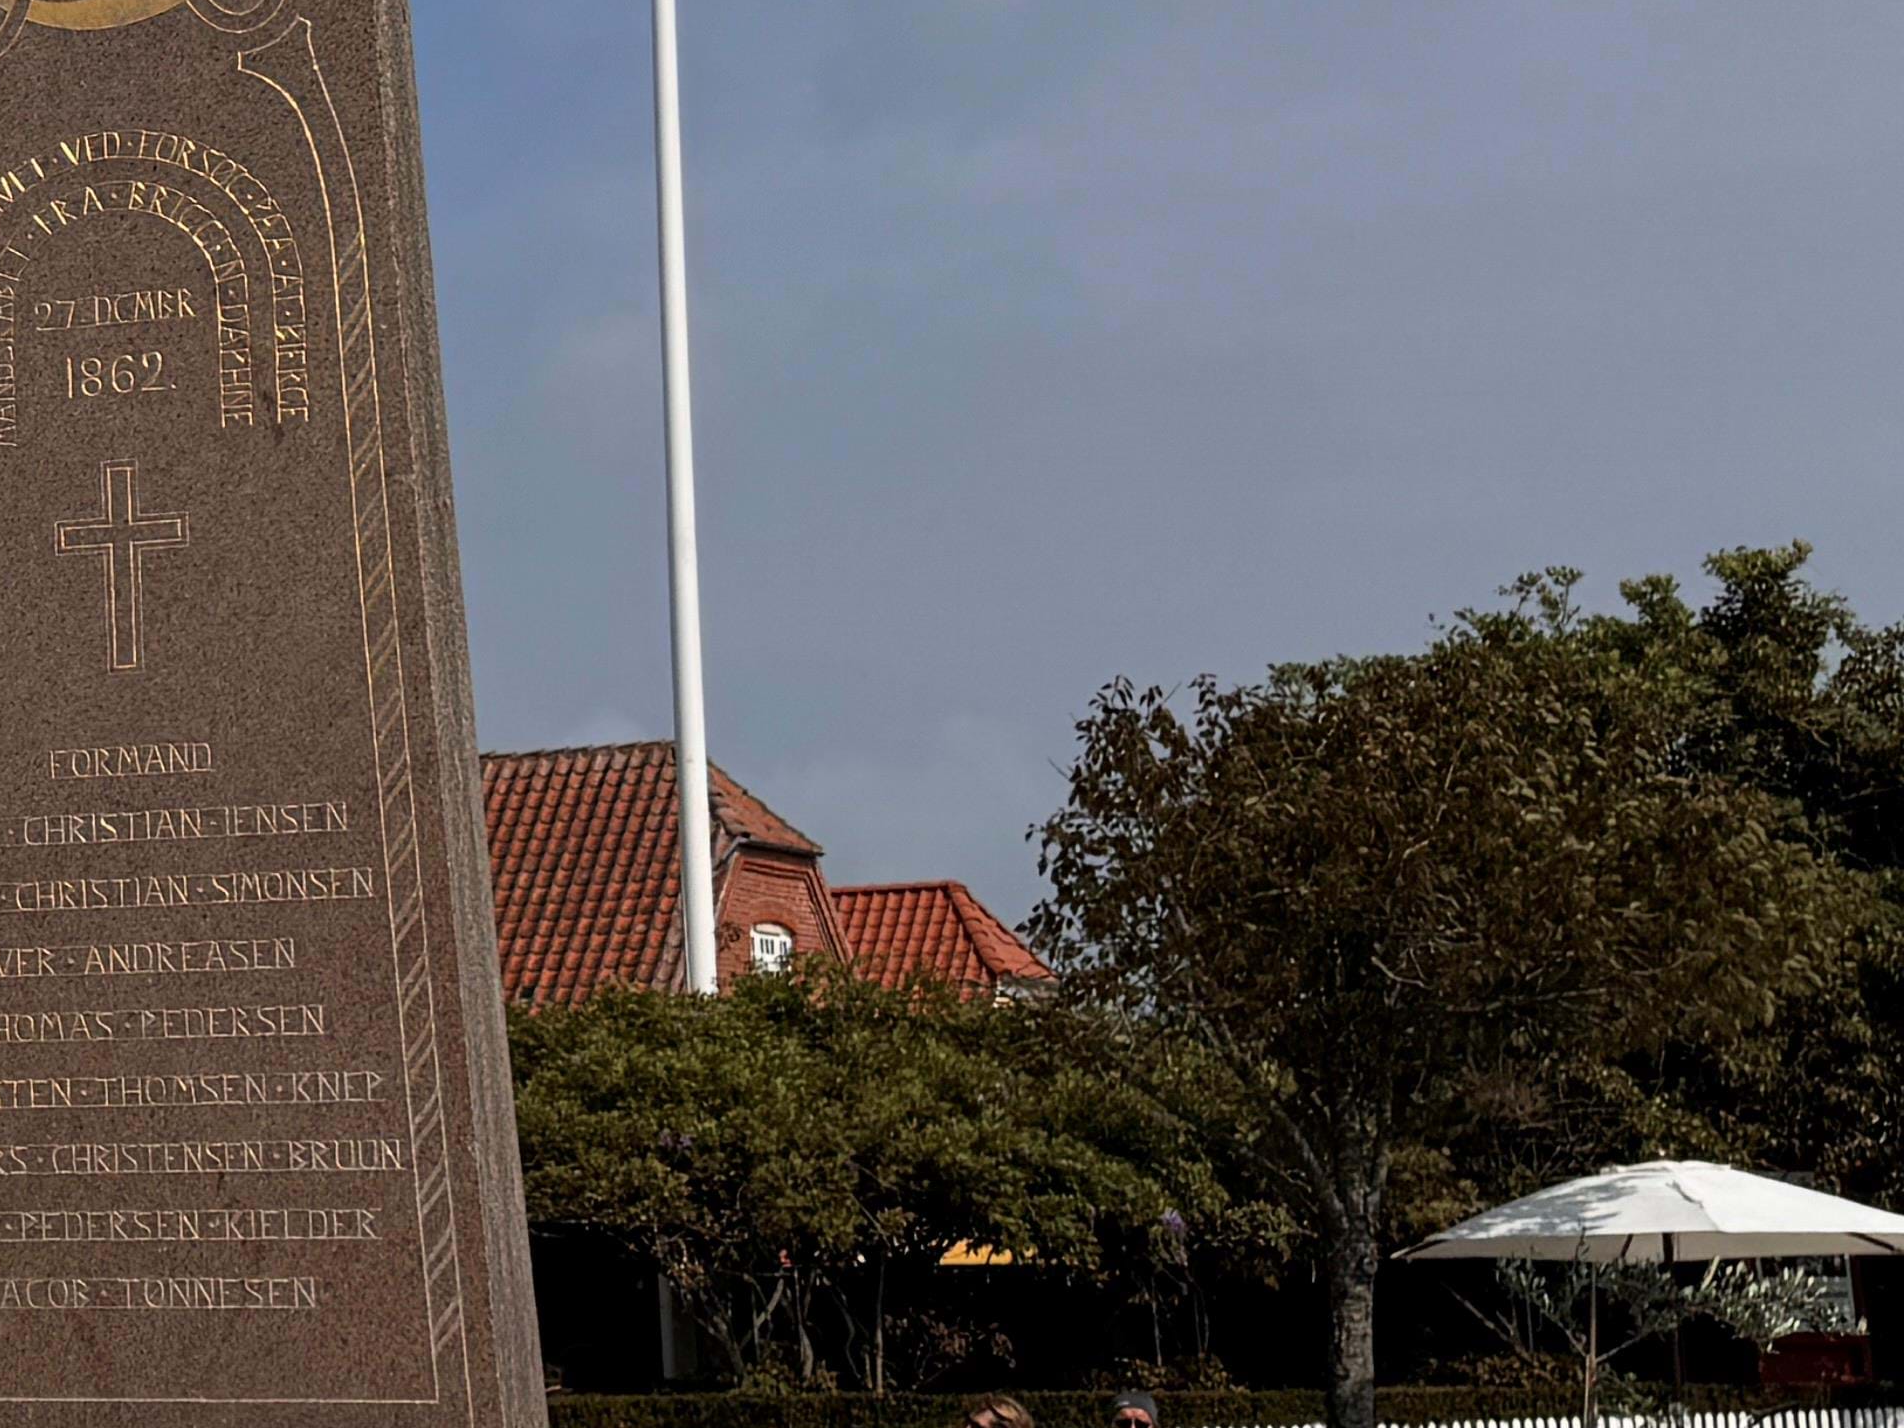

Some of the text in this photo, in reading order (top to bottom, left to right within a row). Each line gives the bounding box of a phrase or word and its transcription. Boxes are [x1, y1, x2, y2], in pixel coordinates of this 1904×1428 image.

[60, 131, 121, 165] VED
[33, 186, 104, 235] FRA
[219, 304, 253, 428] DAPHNE
[67, 351, 177, 398] 1862.
[49, 742, 212, 778] FORMAND
[24, 808, 201, 846] CHRISTIAN
[16, 875, 188, 911] CHRISTIAN
[211, 867, 374, 903] SIMONSEN
[85, 938, 294, 974] ANDREASEN
[141, 1004, 324, 1038] PEDERSEN
[96, 1074, 266, 1106] THOMSEN
[293, 1071, 383, 1103] KNEP
[53, 1142, 263, 1173] CHRISTENSEN
[289, 1139, 401, 1172] BRUUN
[22, 1210, 199, 1240] PEDERSEN
[225, 1208, 380, 1240] KIELDER
